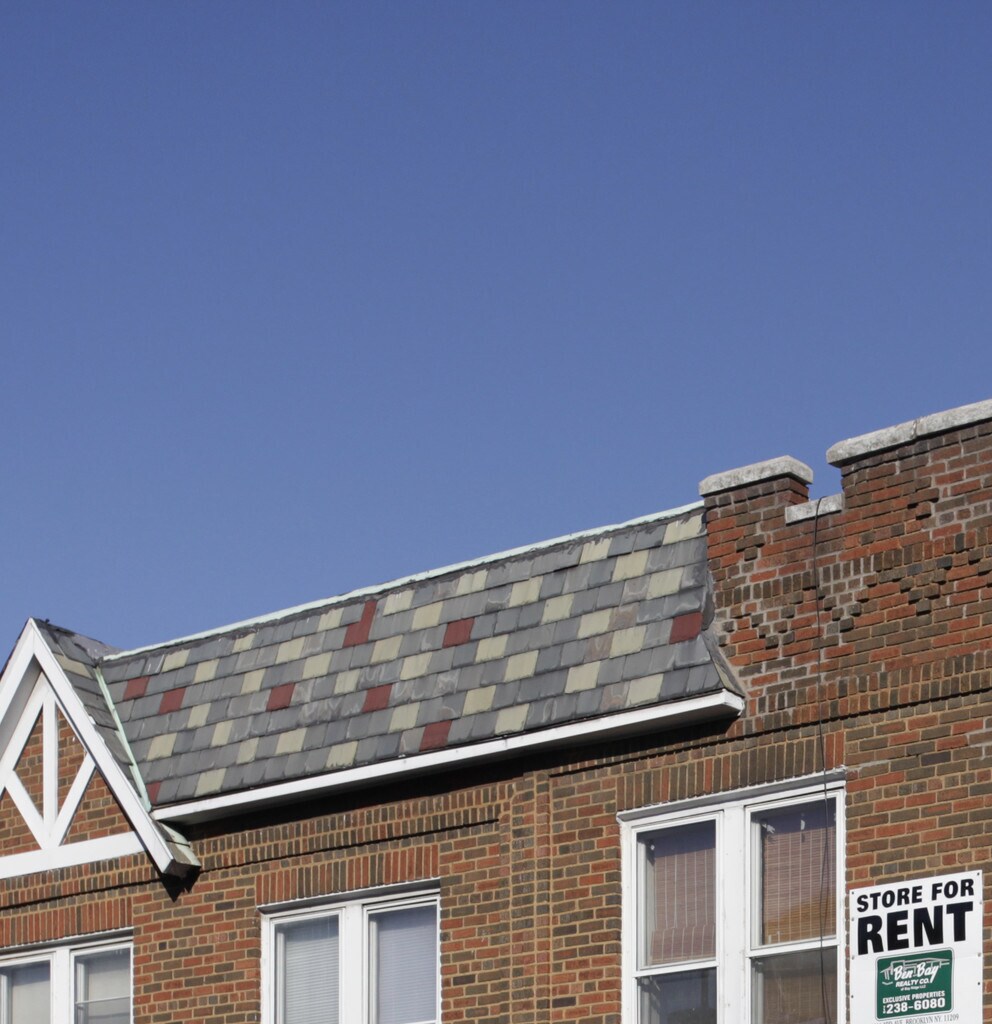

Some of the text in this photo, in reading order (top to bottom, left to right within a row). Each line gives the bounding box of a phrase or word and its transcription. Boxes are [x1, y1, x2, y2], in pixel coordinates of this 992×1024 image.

[857, 878, 975, 912] STORE FOR
[857, 901, 974, 956] RENT
[894, 962, 940, 983] Ben Bay
[895, 979, 918, 988] REALTY
[882, 990, 945, 1004] EXCLUSIVE PROPERTIES
[886, 997, 946, 1014] 238-6080
